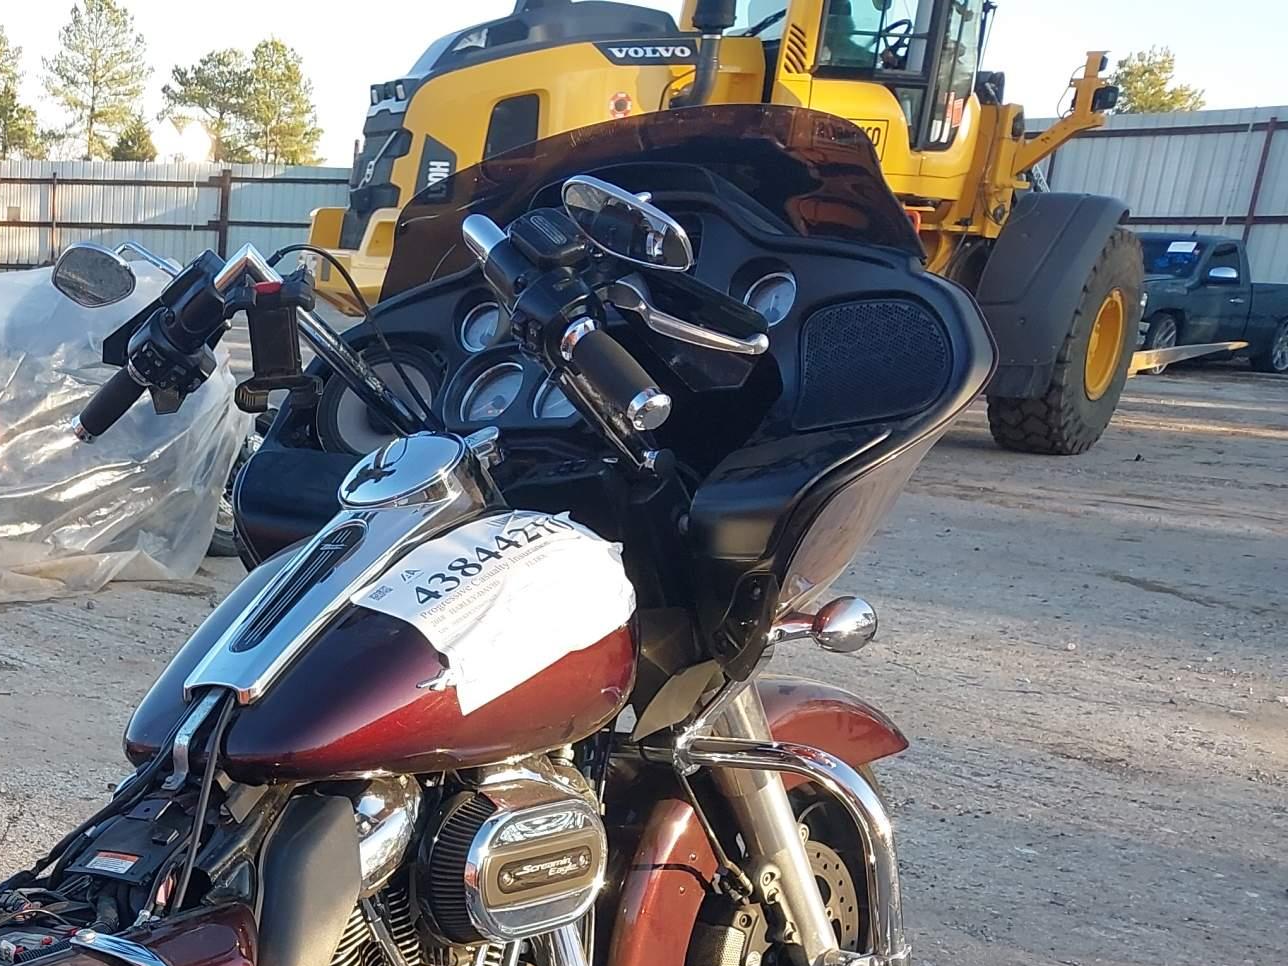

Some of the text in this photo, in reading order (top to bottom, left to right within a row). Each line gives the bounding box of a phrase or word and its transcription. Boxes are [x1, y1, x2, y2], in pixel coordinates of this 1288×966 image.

[608, 46, 691, 58] VOLVO
[419, 585, 473, 620] Progressive
[471, 562, 510, 588] Casualty
[548, 863, 580, 877] Eagle
